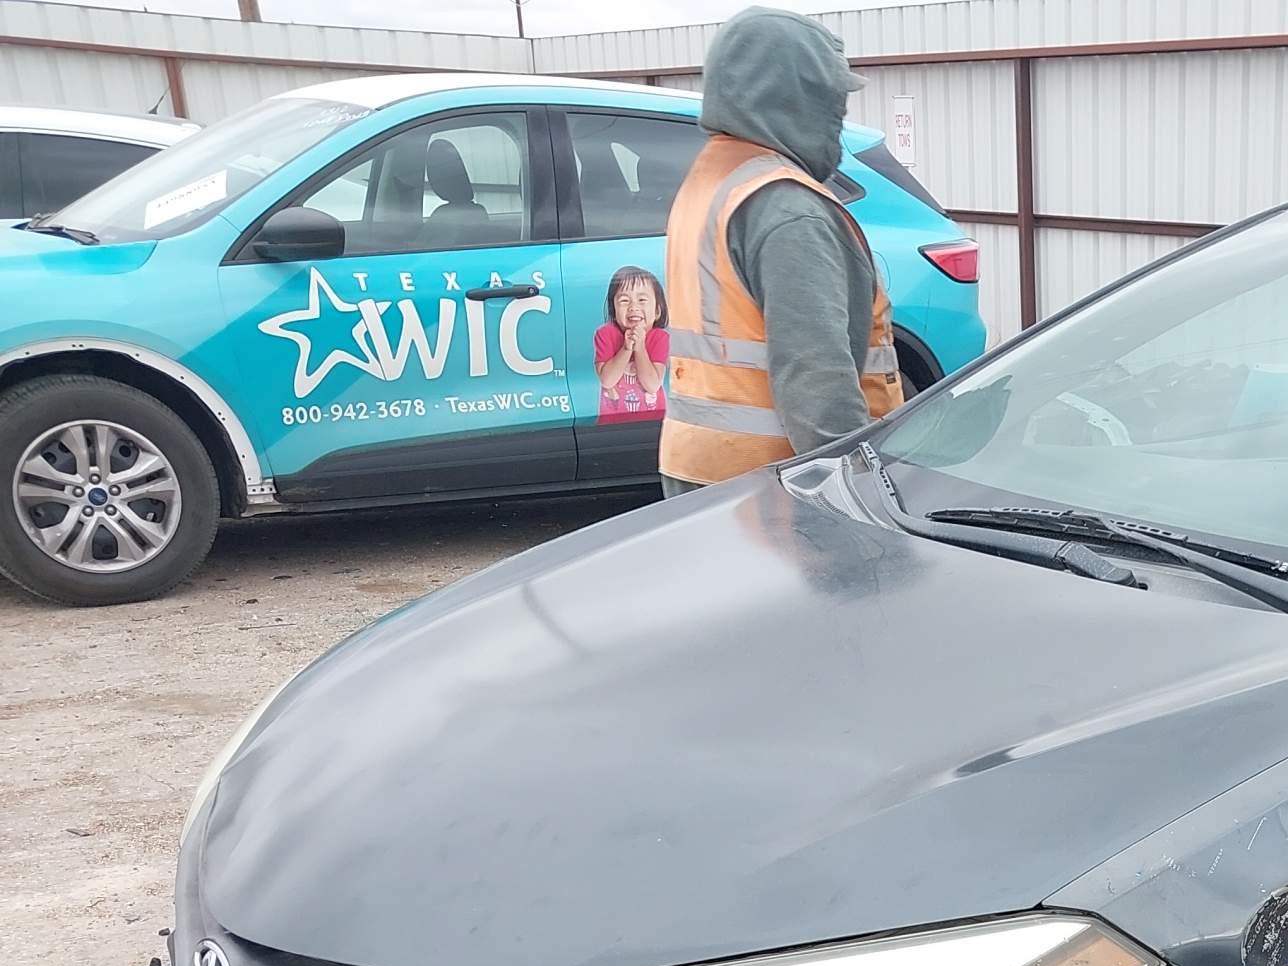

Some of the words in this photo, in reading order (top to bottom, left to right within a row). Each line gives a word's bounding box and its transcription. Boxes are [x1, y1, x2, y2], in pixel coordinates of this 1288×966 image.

[353, 271, 545, 293] TEXAS
[358, 296, 553, 381] WIC
[281, 398, 427, 425] 800-942-3678
[445, 390, 571, 414] TexasWIC.org
